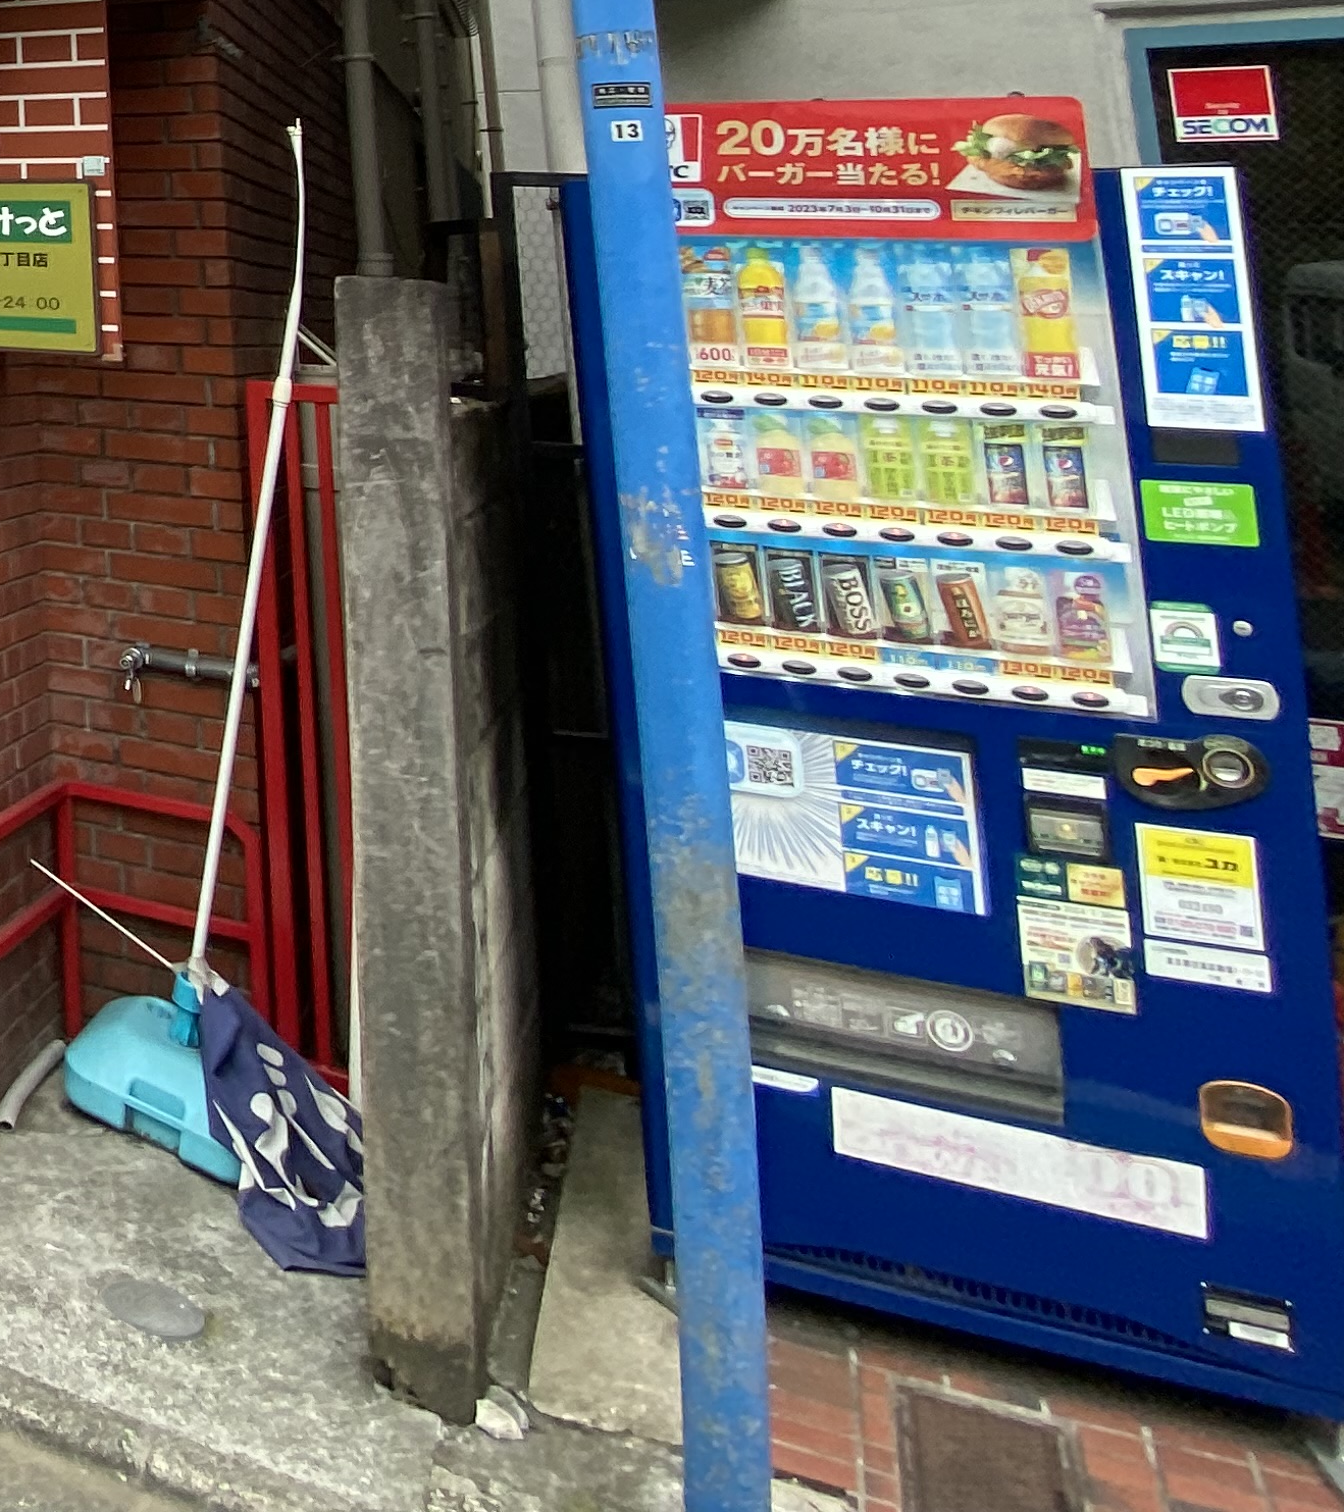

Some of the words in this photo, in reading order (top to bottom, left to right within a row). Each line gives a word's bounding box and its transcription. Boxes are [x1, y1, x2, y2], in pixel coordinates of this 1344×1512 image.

[615, 123, 639, 139] 13
[716, 120, 941, 157] 20万名様に
[1182, 118, 1269, 135] SECOM
[837, 576, 872, 631] BOSS
